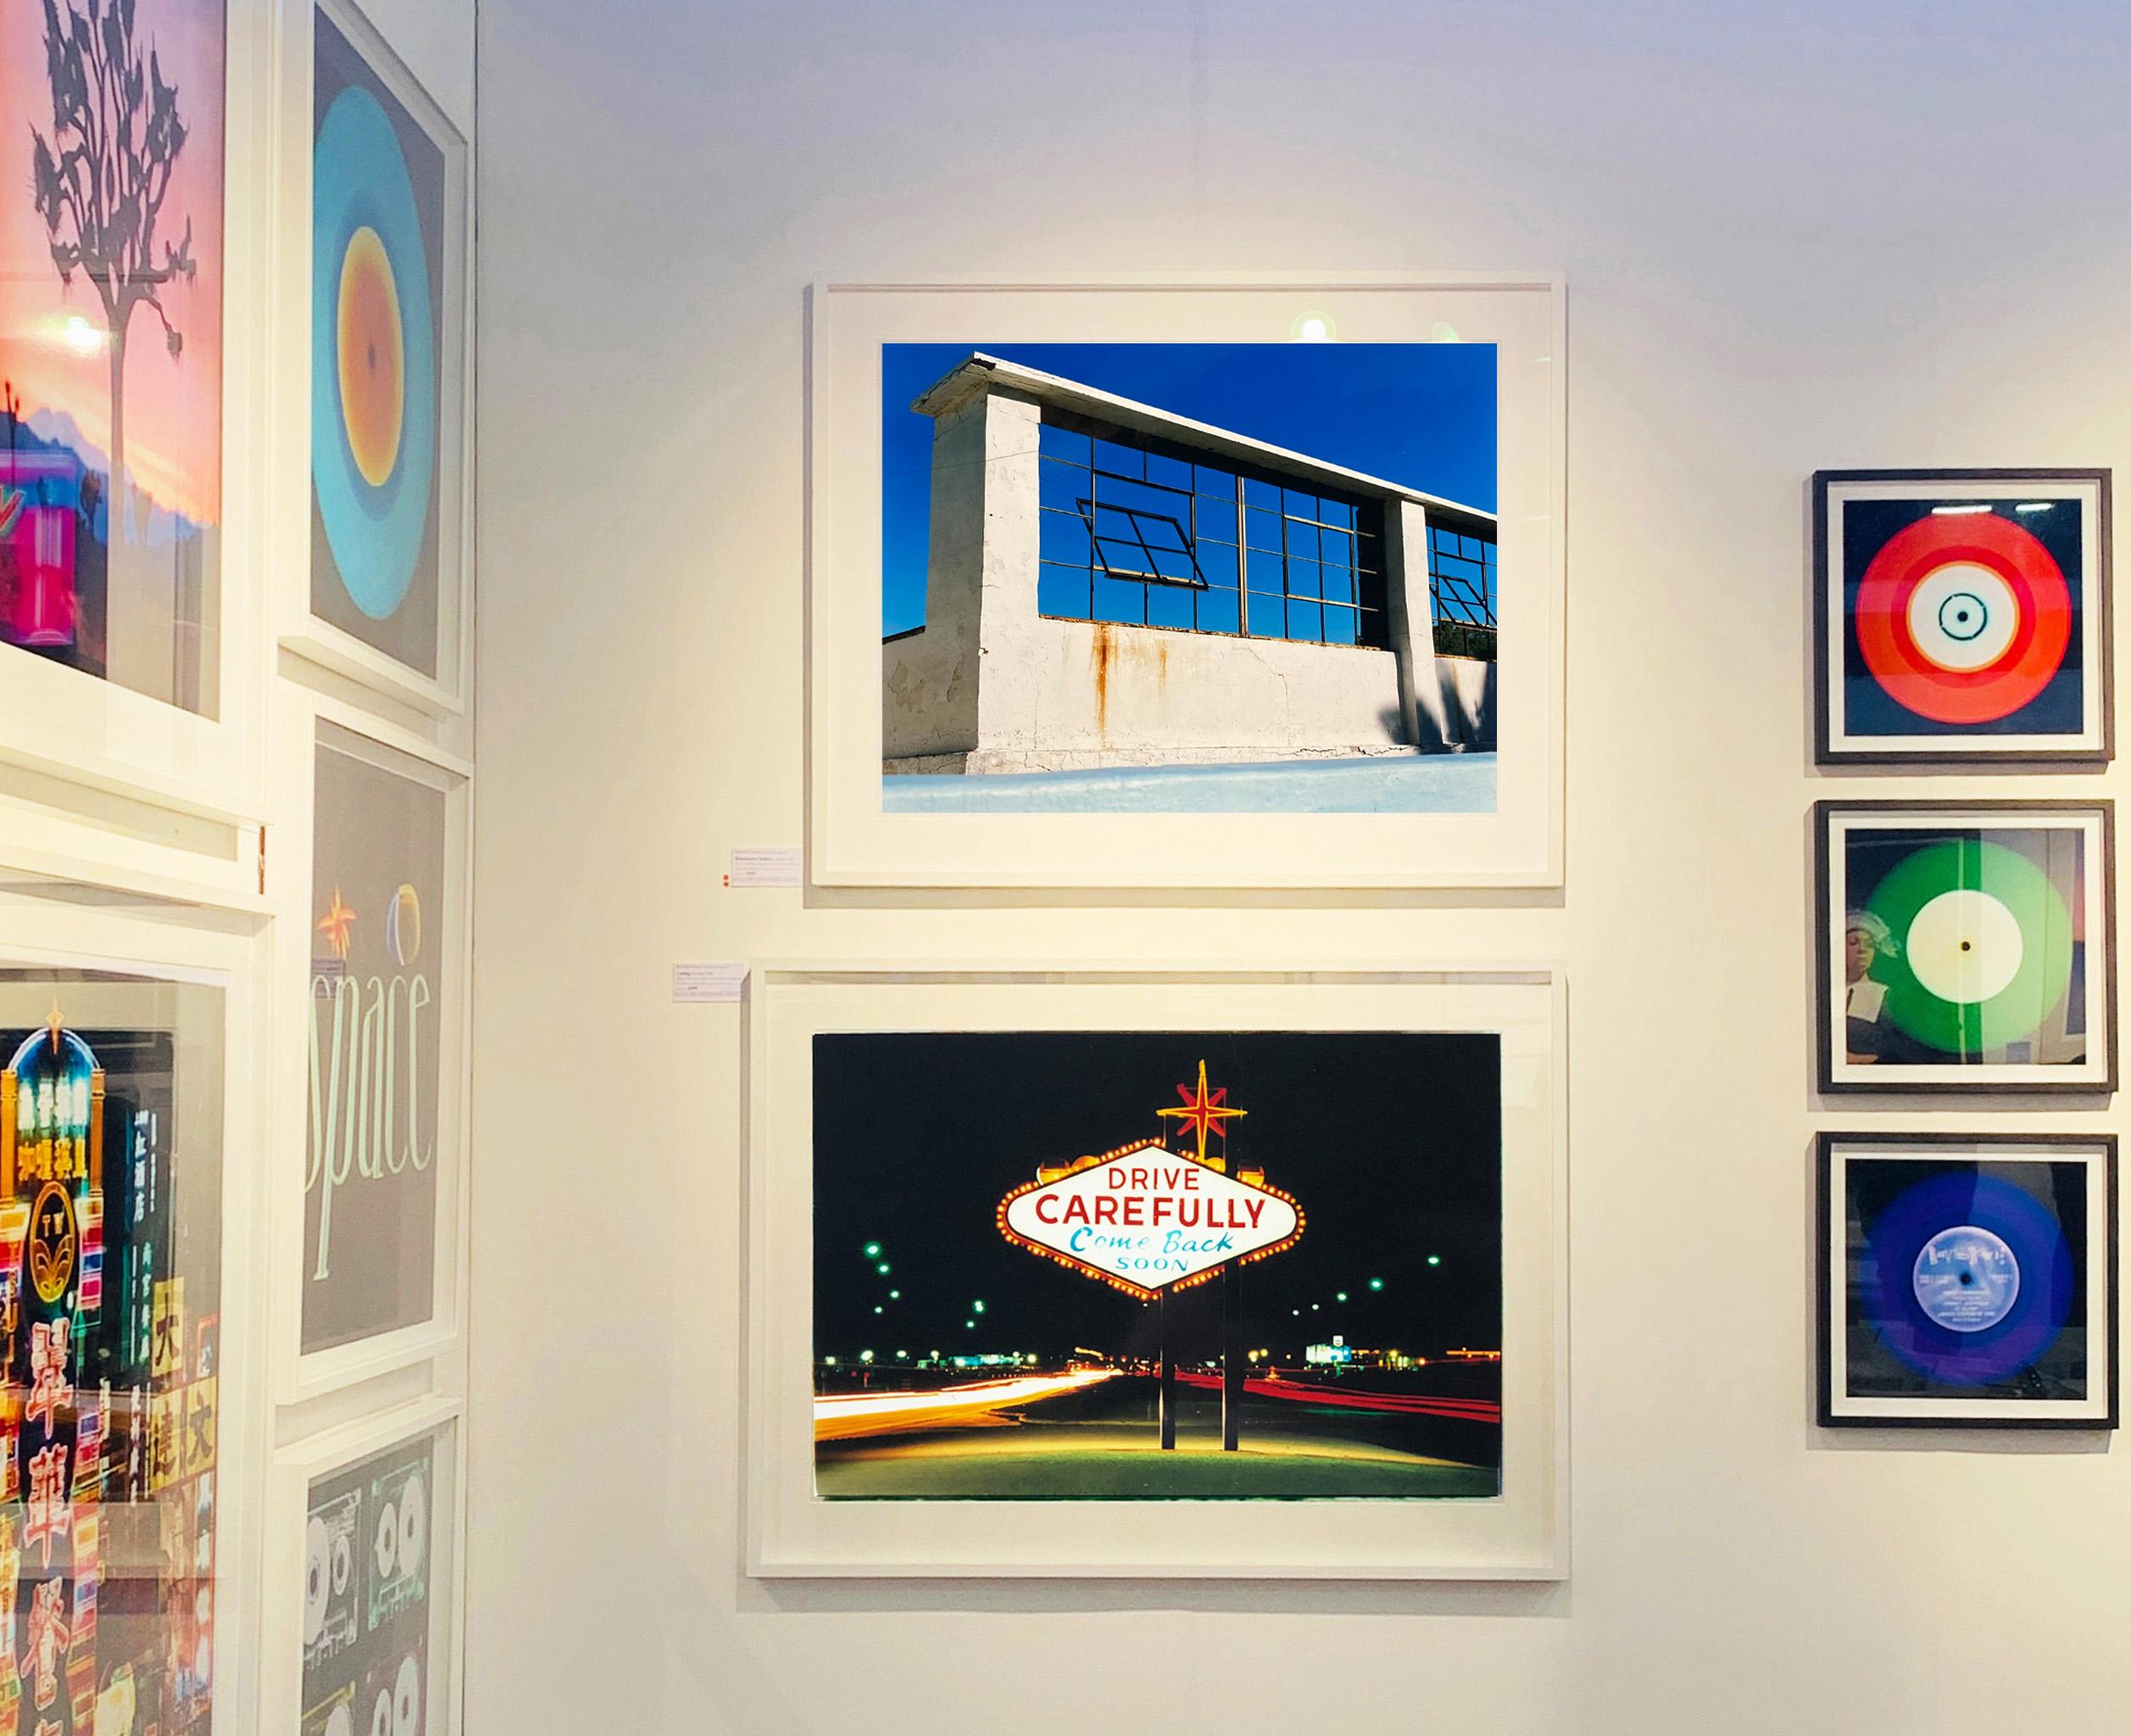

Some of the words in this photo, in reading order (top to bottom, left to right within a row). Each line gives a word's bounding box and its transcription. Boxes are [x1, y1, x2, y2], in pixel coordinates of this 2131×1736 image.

[1109, 1167, 1199, 1190] DRIVE
[1035, 1193, 1266, 1228] CAREFULLY
[1070, 1227, 1150, 1252] Come
[1163, 1230, 1234, 1254] Back
[1115, 1259, 1189, 1271] SOON
